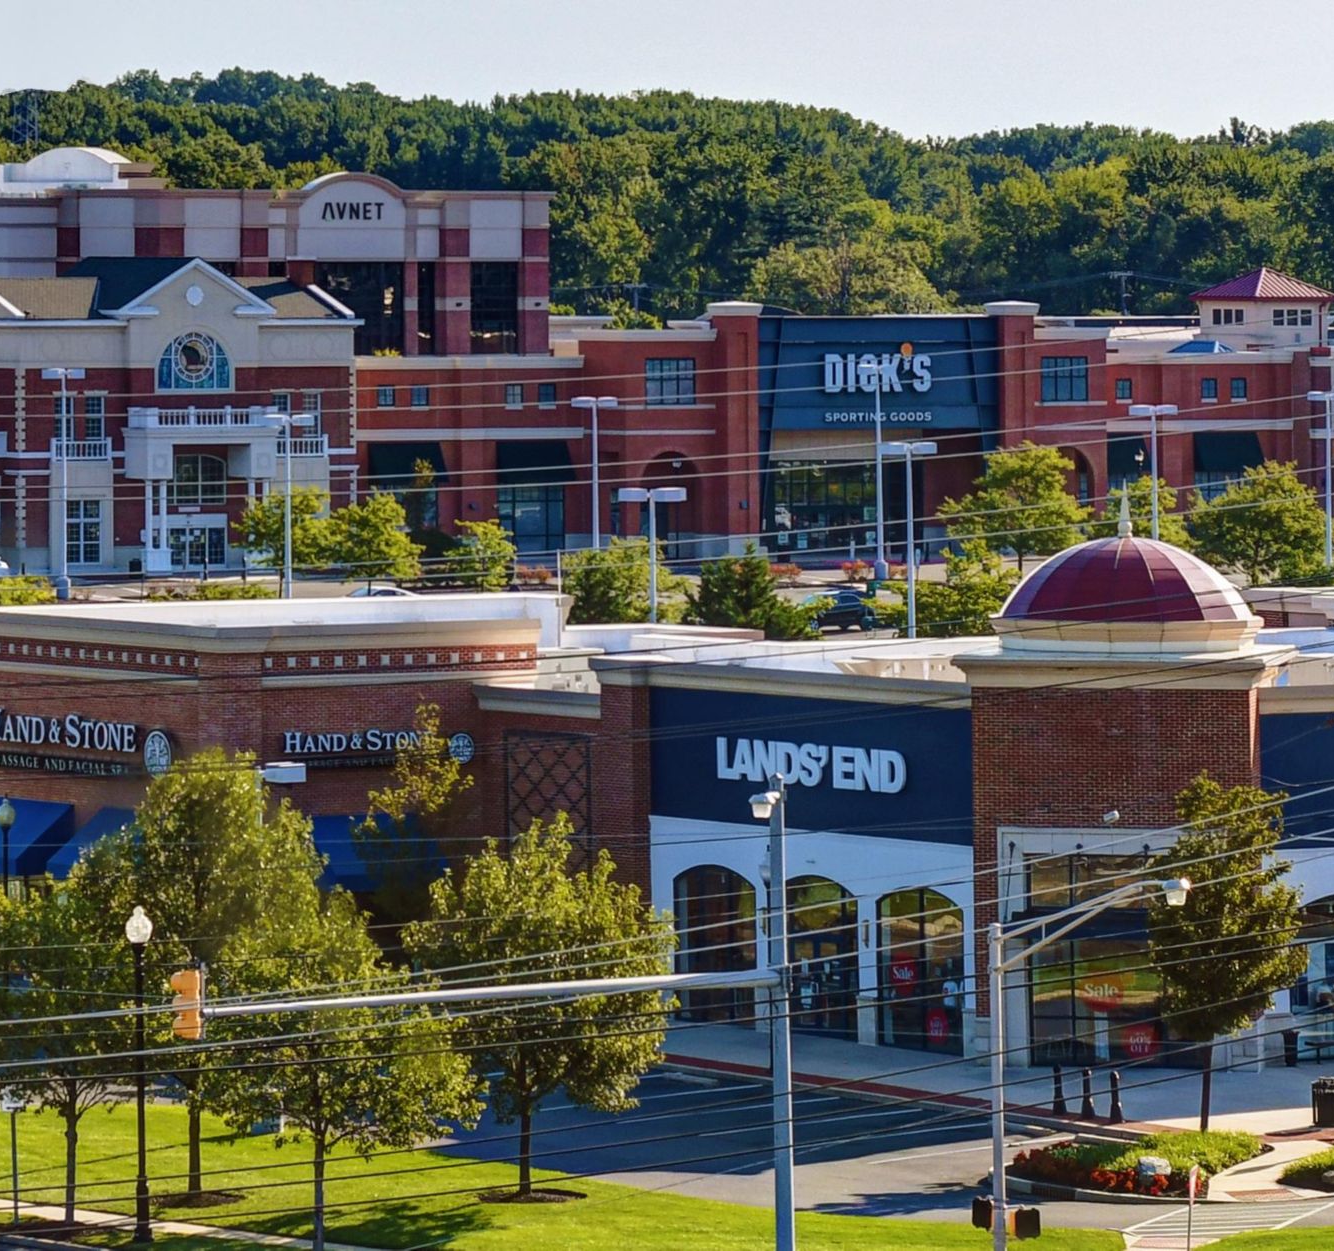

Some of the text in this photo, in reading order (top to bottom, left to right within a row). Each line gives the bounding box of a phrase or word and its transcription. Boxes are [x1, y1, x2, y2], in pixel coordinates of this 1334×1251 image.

[321, 202, 385, 220] AVNET
[824, 353, 932, 393] DICK'S
[824, 411, 932, 423] SPORTING GOODS
[48, 717, 61, 745] &
[65, 714, 137, 753] STONE
[283, 729, 433, 754] HAND & STON
[43, 757, 67, 773] AND
[68, 760, 107, 776] FACIAL
[716, 737, 908, 795] LANDS' END
[892, 966, 915, 980] Sale
[1084, 983, 1120, 998] Sale
